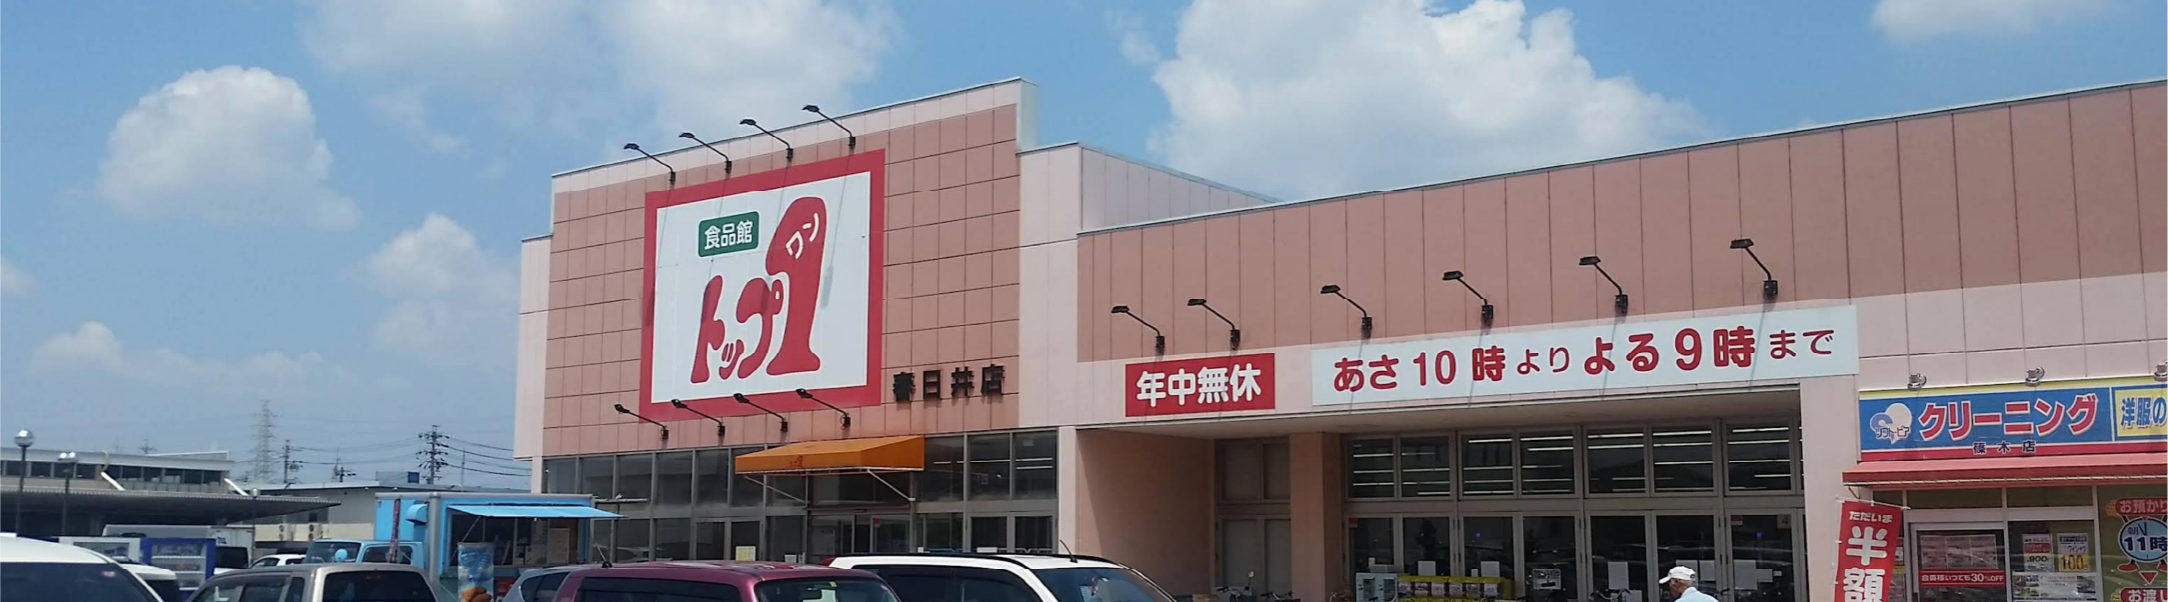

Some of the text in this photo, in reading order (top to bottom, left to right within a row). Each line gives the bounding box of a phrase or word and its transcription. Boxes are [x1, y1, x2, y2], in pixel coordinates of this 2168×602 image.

[704, 220, 753, 250] 食品館
[785, 212, 820, 259] ワン
[892, 363, 1005, 402] 春日井店
[1136, 363, 1262, 407] 年中無休
[1918, 392, 2097, 441] クリーニング
[2120, 396, 2167, 428] 洋服の
[1848, 511, 1893, 524] ただいま
[1843, 525, 1888, 602] 半額
